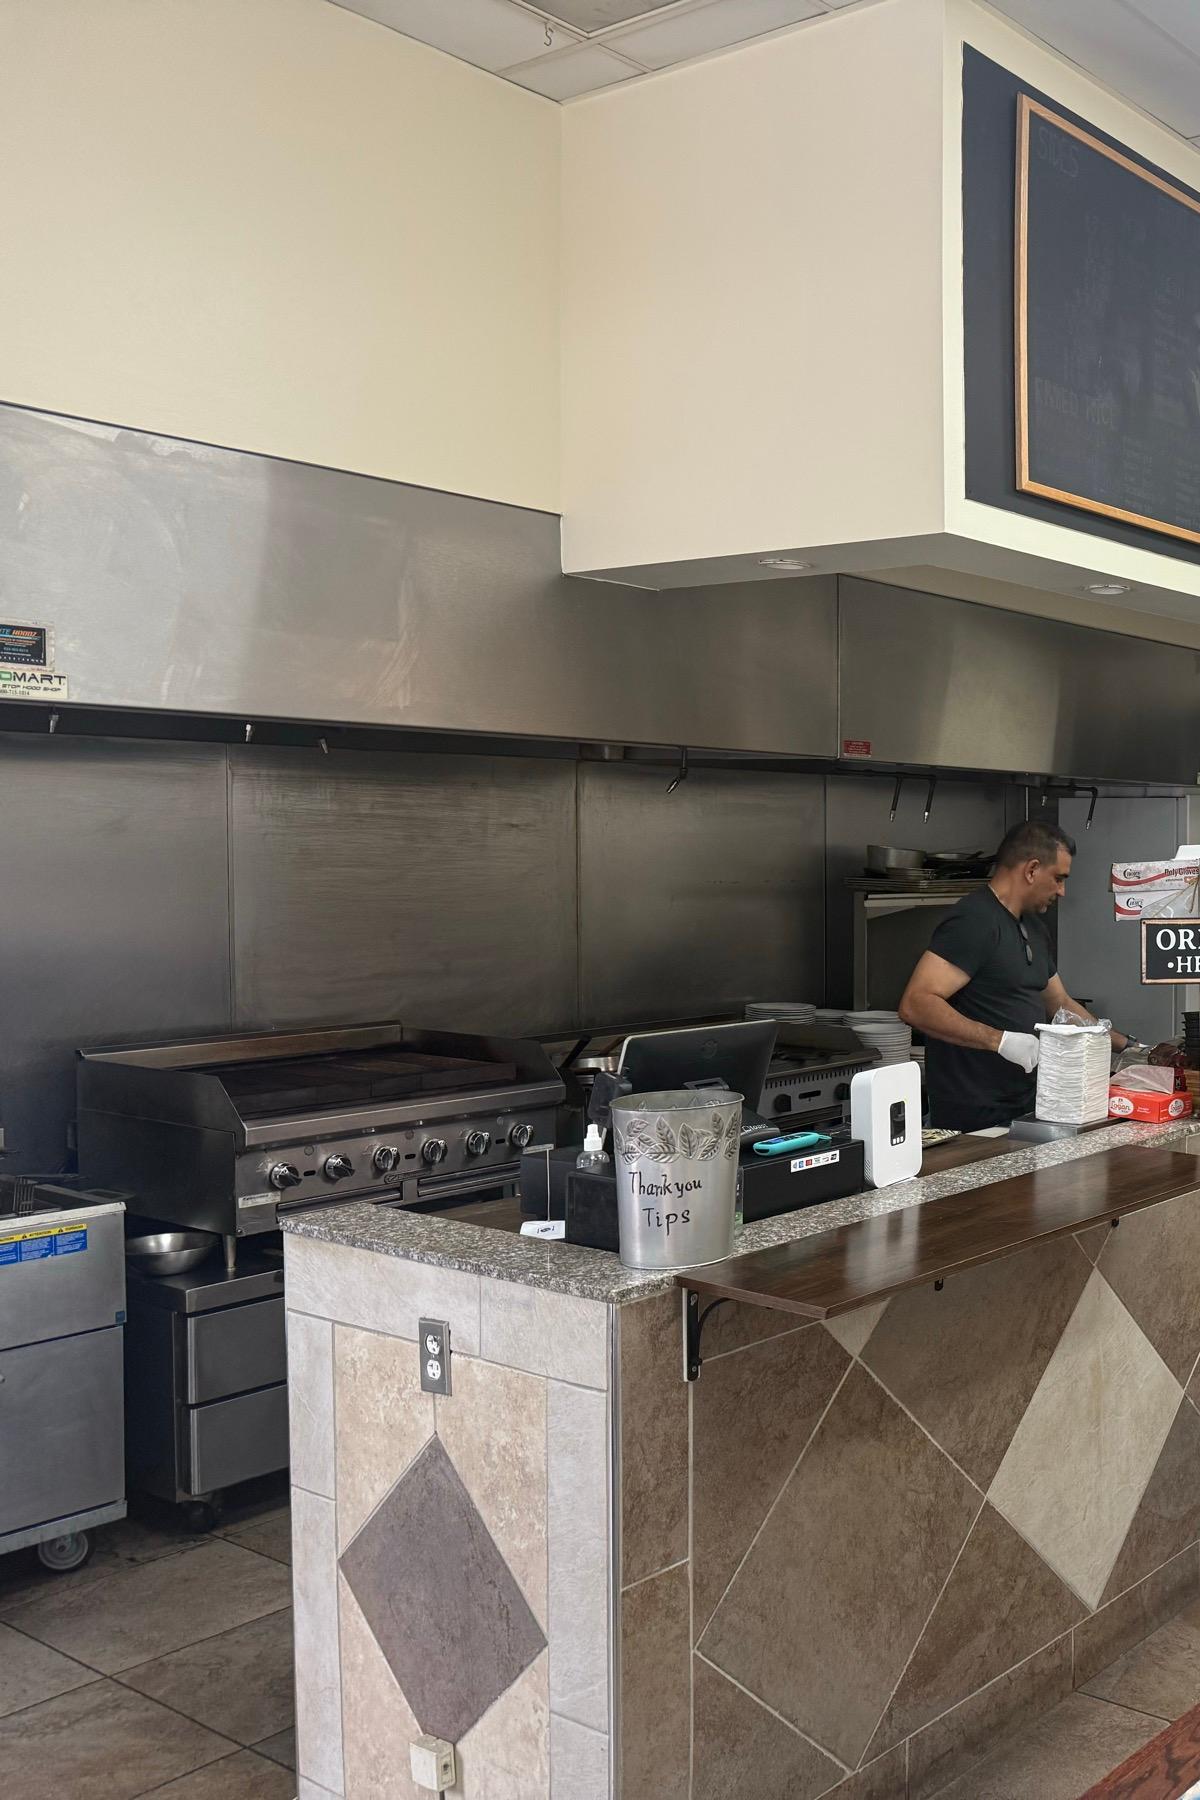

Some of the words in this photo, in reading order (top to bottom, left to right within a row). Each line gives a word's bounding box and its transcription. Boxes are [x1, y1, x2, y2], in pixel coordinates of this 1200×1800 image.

[628, 1171, 672, 1196] Thank
[676, 1179, 703, 1198] you
[642, 1207, 691, 1236] Tips
